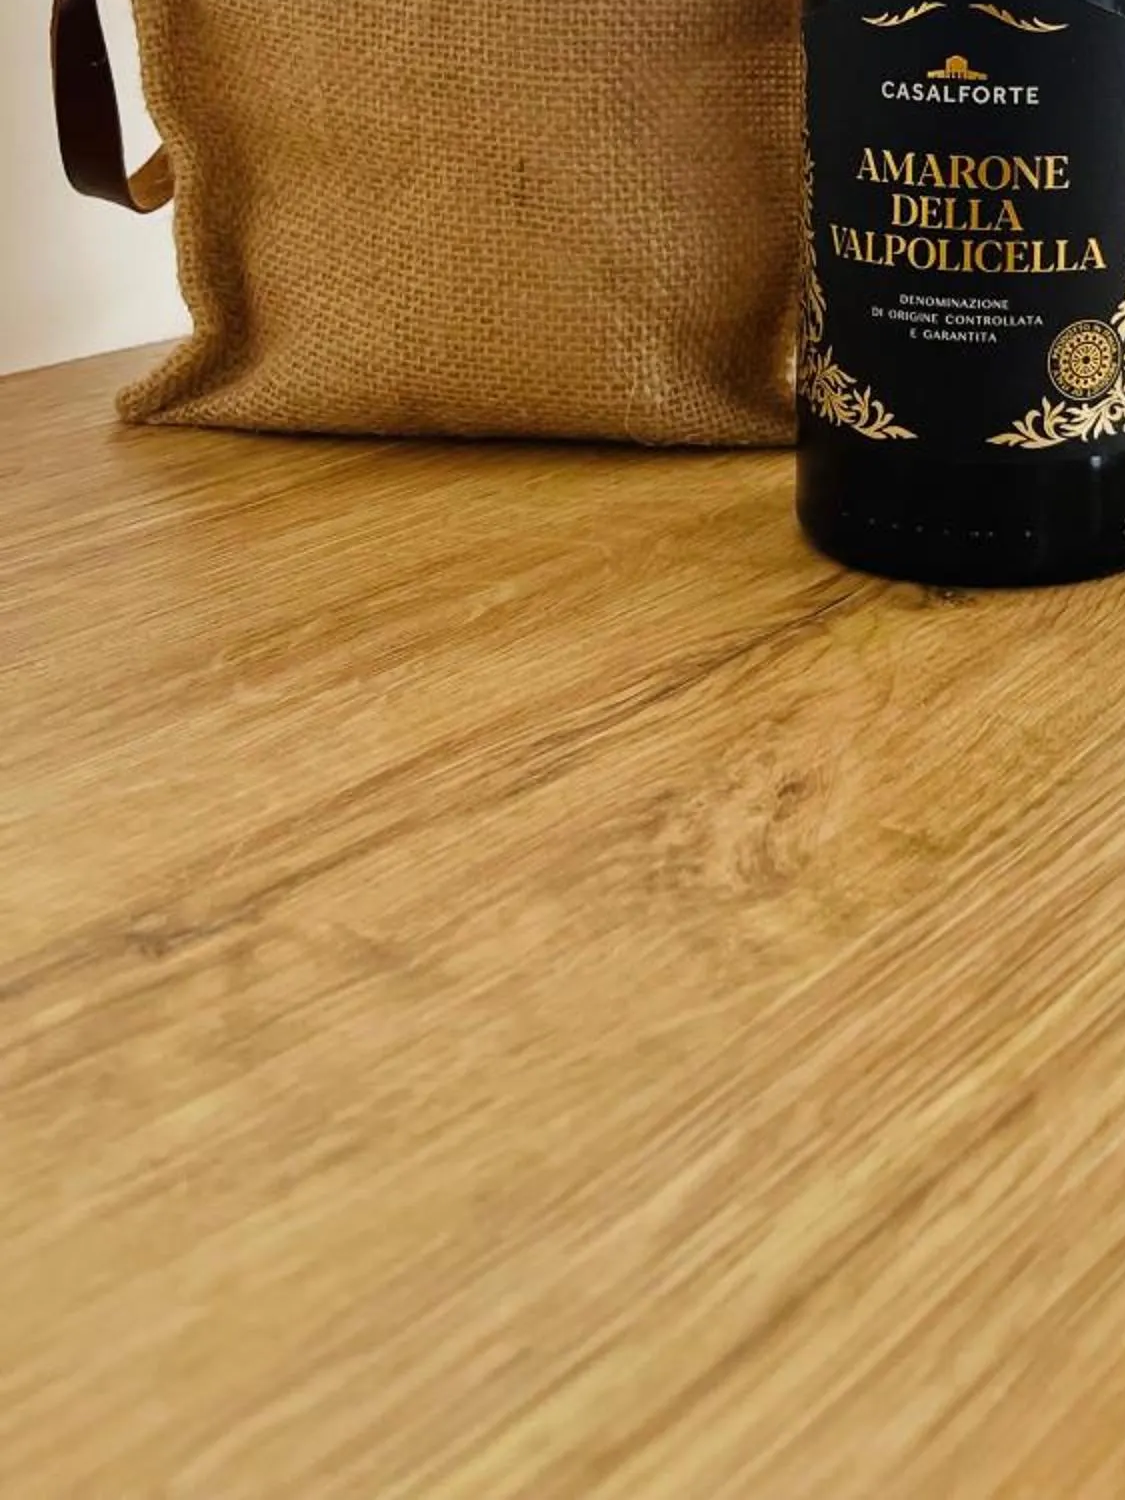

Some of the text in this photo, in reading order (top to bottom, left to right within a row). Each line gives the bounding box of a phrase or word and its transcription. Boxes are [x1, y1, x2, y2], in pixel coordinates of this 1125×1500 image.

[881, 80, 1039, 105] CASALFORTE
[856, 147, 1070, 190] AMARONE
[891, 193, 1023, 231] DELLA
[830, 223, 1107, 273] VALPOLICELLA
[899, 293, 1009, 310] DENOMINAZIONE
[871, 305, 1044, 327] DI ORIGINE CONTROLLATA
[909, 327, 998, 344] E GARANTITA
